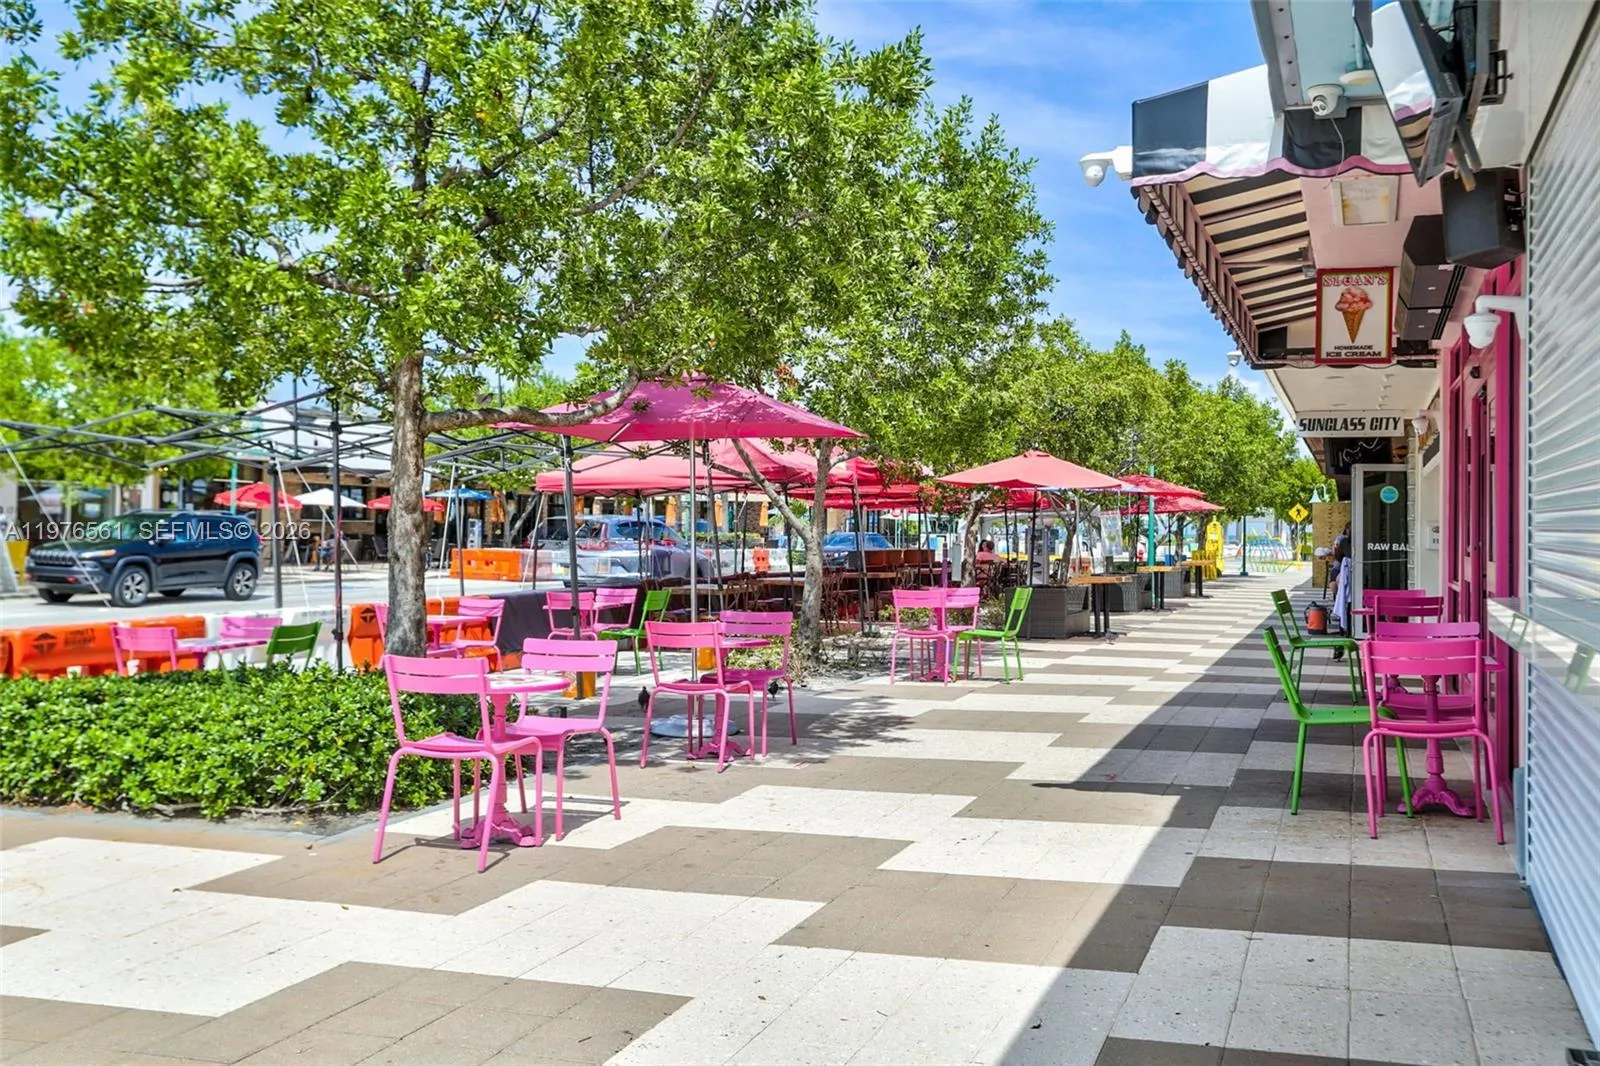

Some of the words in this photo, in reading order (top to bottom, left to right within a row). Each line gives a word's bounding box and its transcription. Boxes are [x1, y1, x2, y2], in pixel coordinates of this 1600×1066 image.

[1322, 274, 1387, 287] SLOAN'S
[1299, 417, 1366, 431] SUNGLASS
[1370, 417, 1400, 431] CITY
[1367, 542, 1390, 551] RAW
